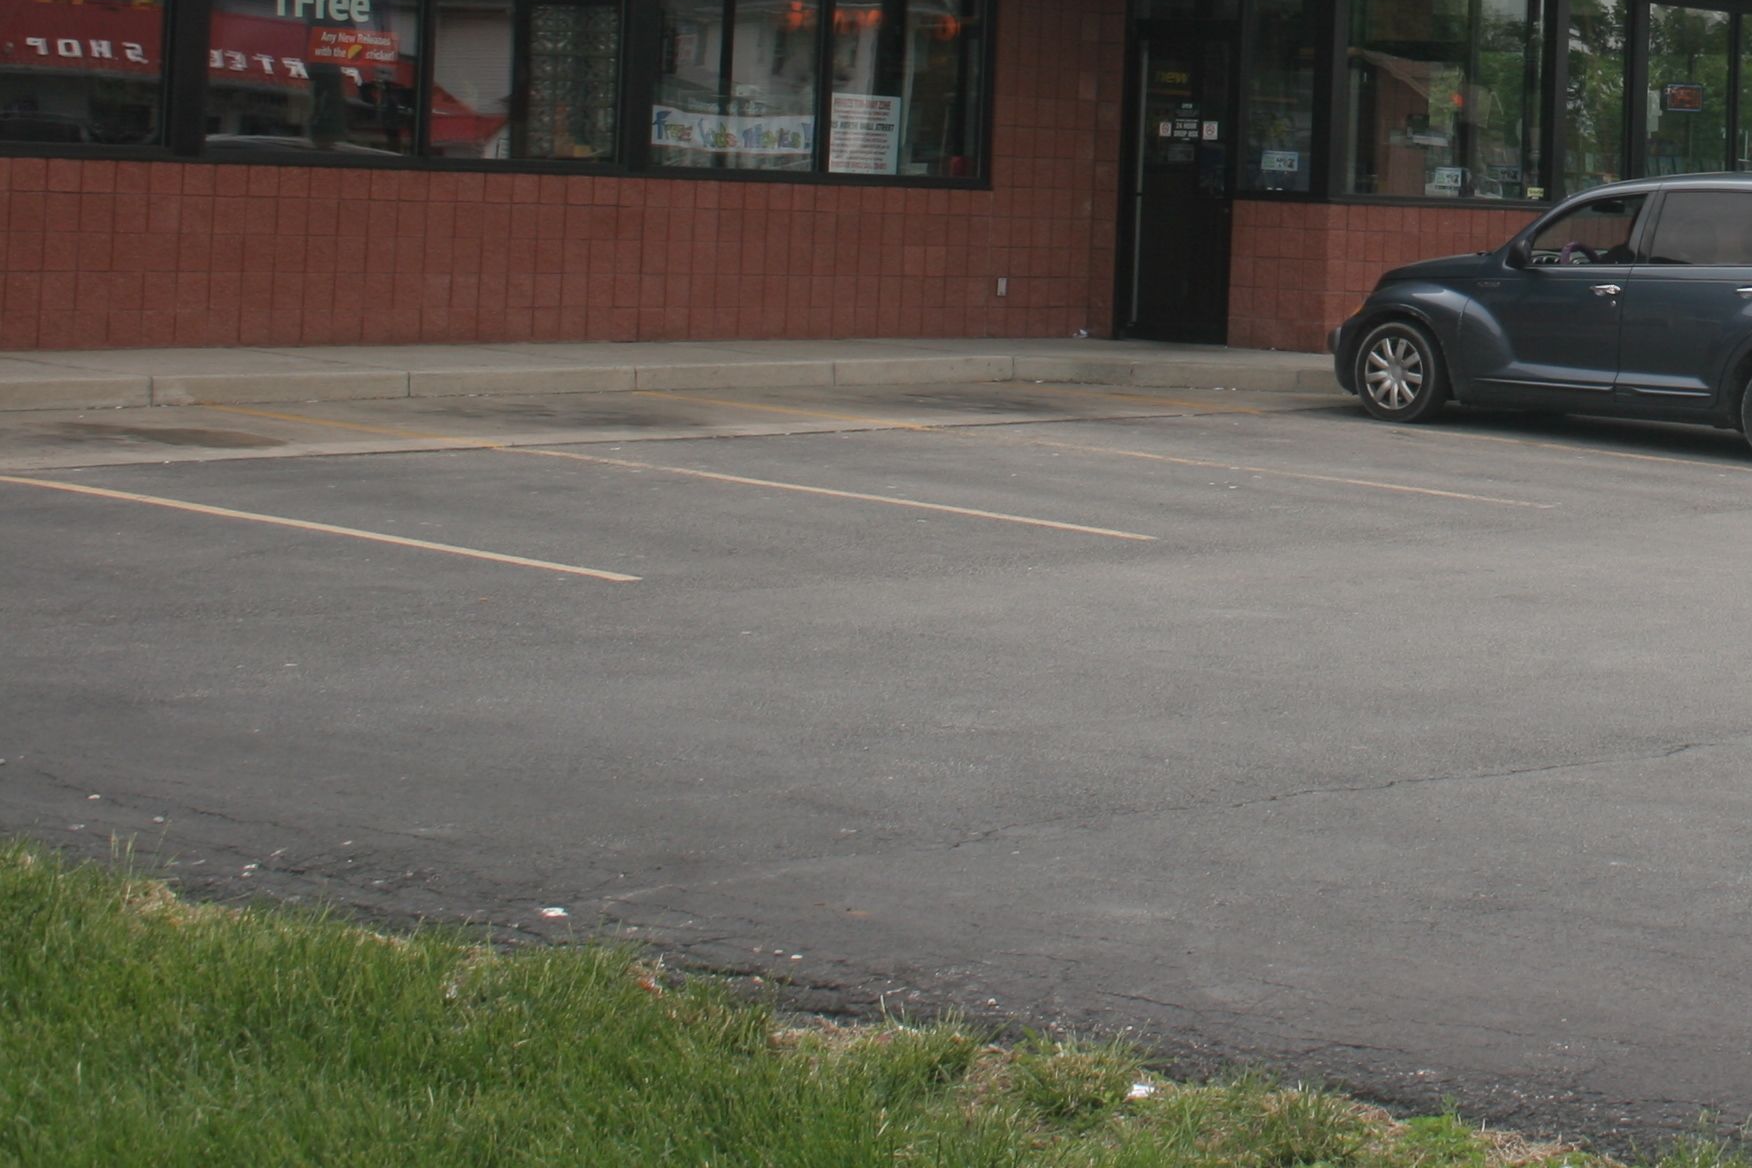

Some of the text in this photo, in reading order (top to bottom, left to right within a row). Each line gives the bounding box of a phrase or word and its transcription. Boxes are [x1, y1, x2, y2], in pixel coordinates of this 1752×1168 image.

[320, 31, 337, 45] Any
[338, 33, 356, 44] New
[314, 46, 333, 57] with
[333, 47, 347, 58] the
